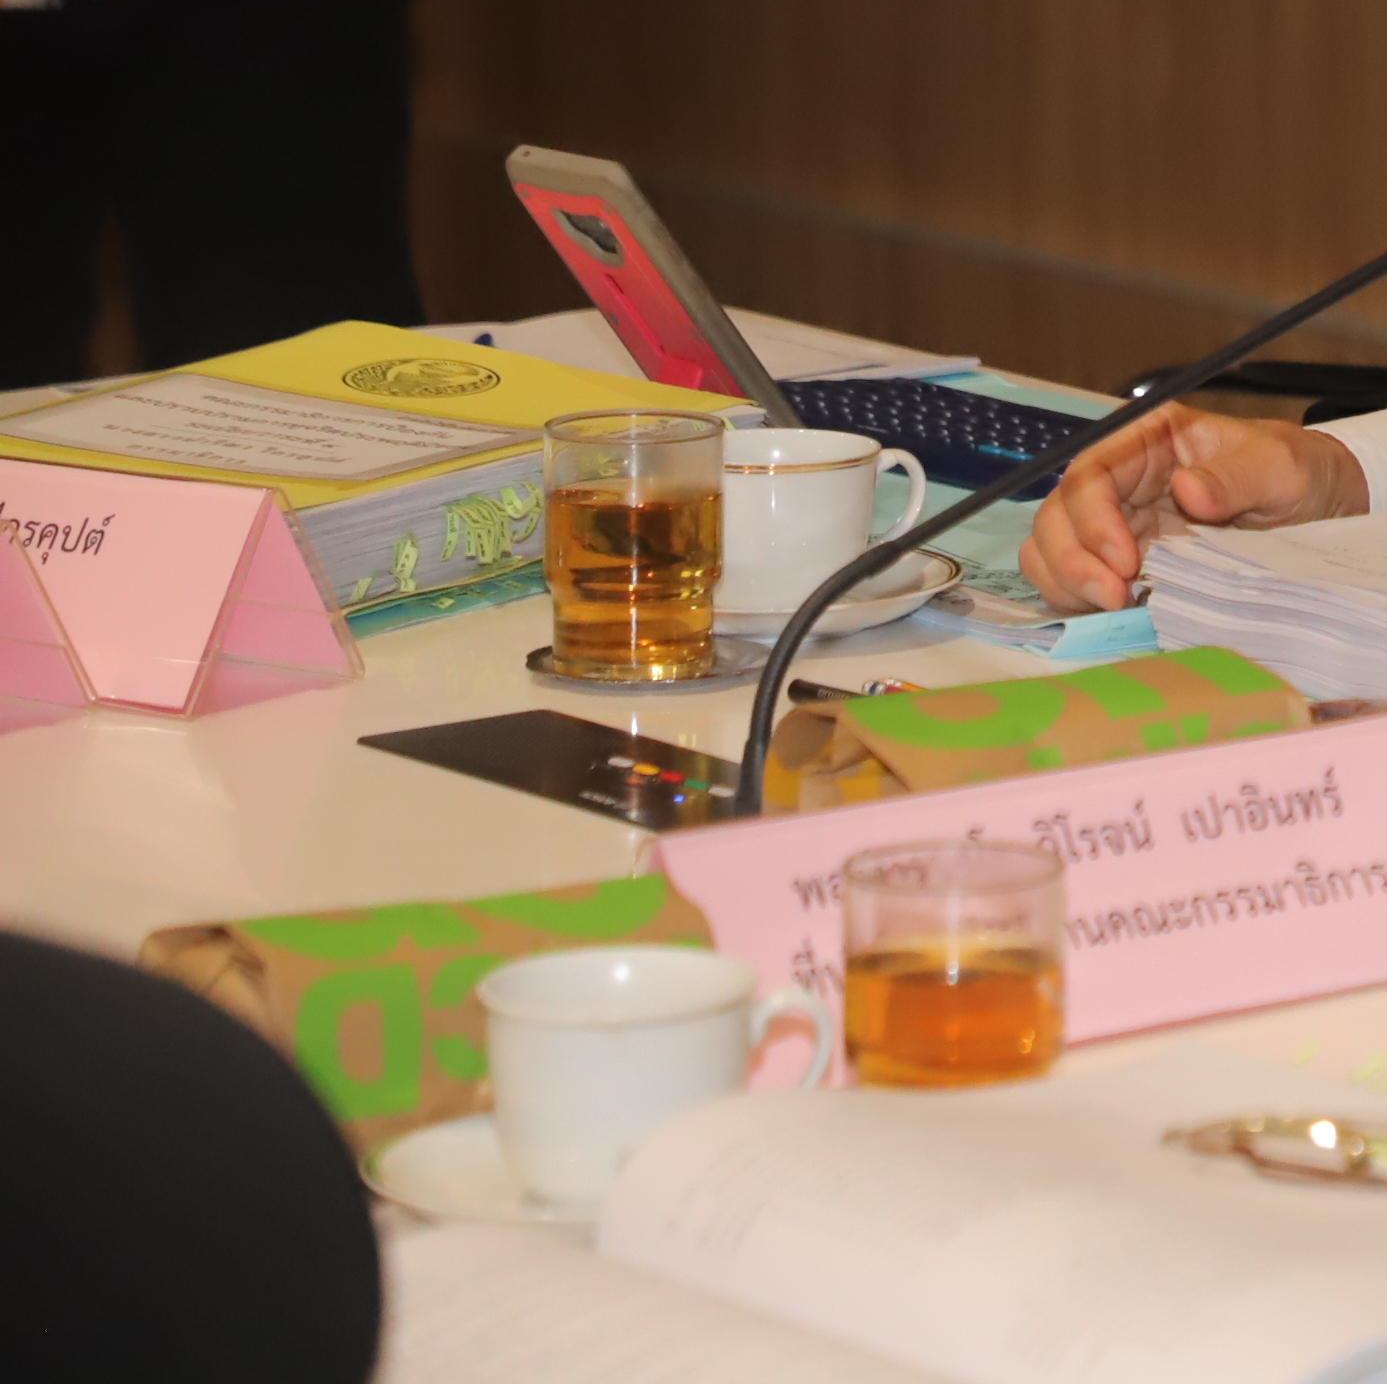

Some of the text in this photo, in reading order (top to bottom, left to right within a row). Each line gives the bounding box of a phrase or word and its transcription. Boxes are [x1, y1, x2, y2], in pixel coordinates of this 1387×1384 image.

[0, 501, 116, 565] กรคุปต์
[1180, 765, 1344, 844] เปาอินทร์
